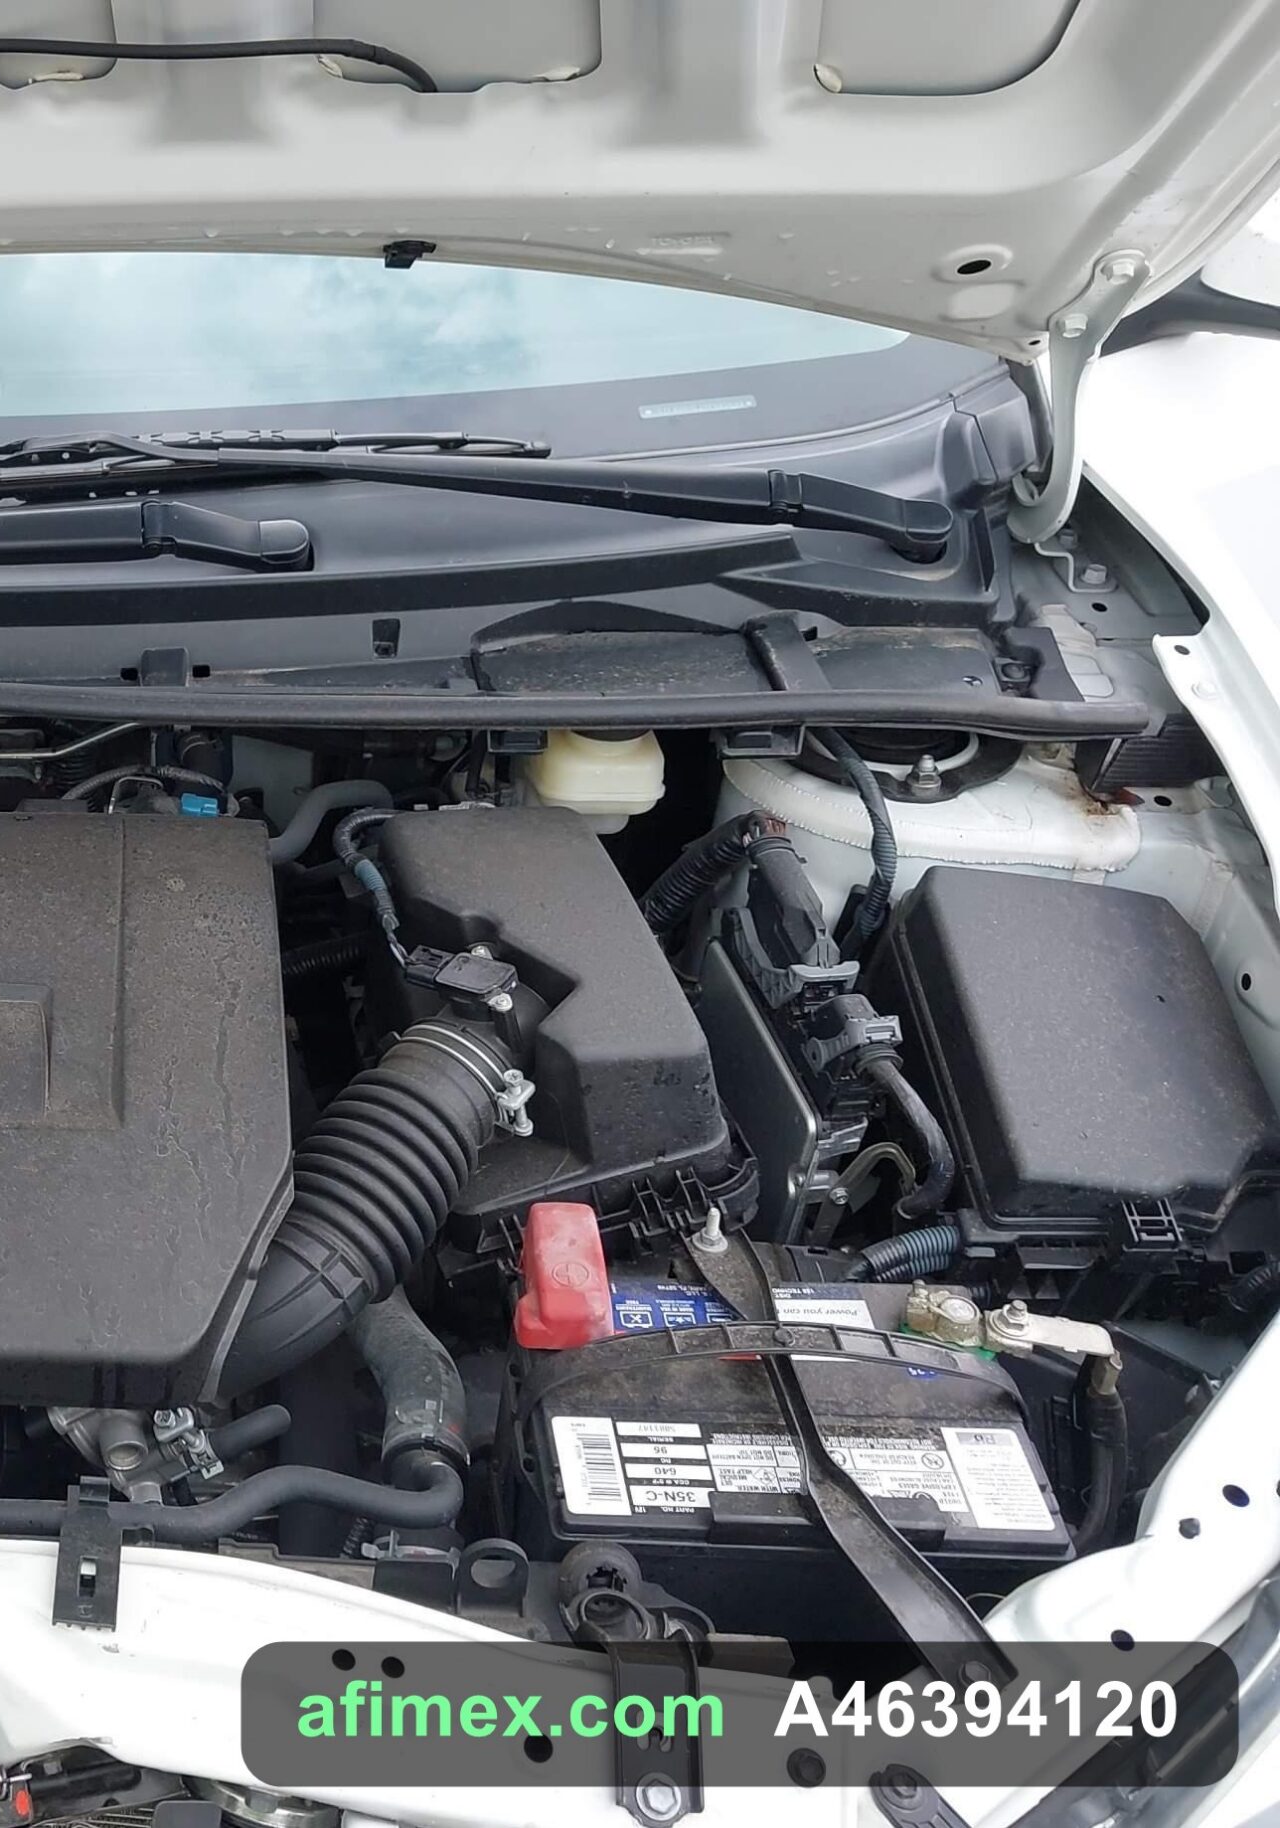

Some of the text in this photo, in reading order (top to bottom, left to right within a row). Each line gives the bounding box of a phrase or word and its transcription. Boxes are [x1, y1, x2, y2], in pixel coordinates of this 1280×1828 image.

[803, 1307, 823, 1315] you
[824, 1308, 858, 1316] Power
[653, 1446, 668, 1454] 96
[654, 1467, 676, 1476] 640
[646, 1490, 696, 1502] 35N-C
